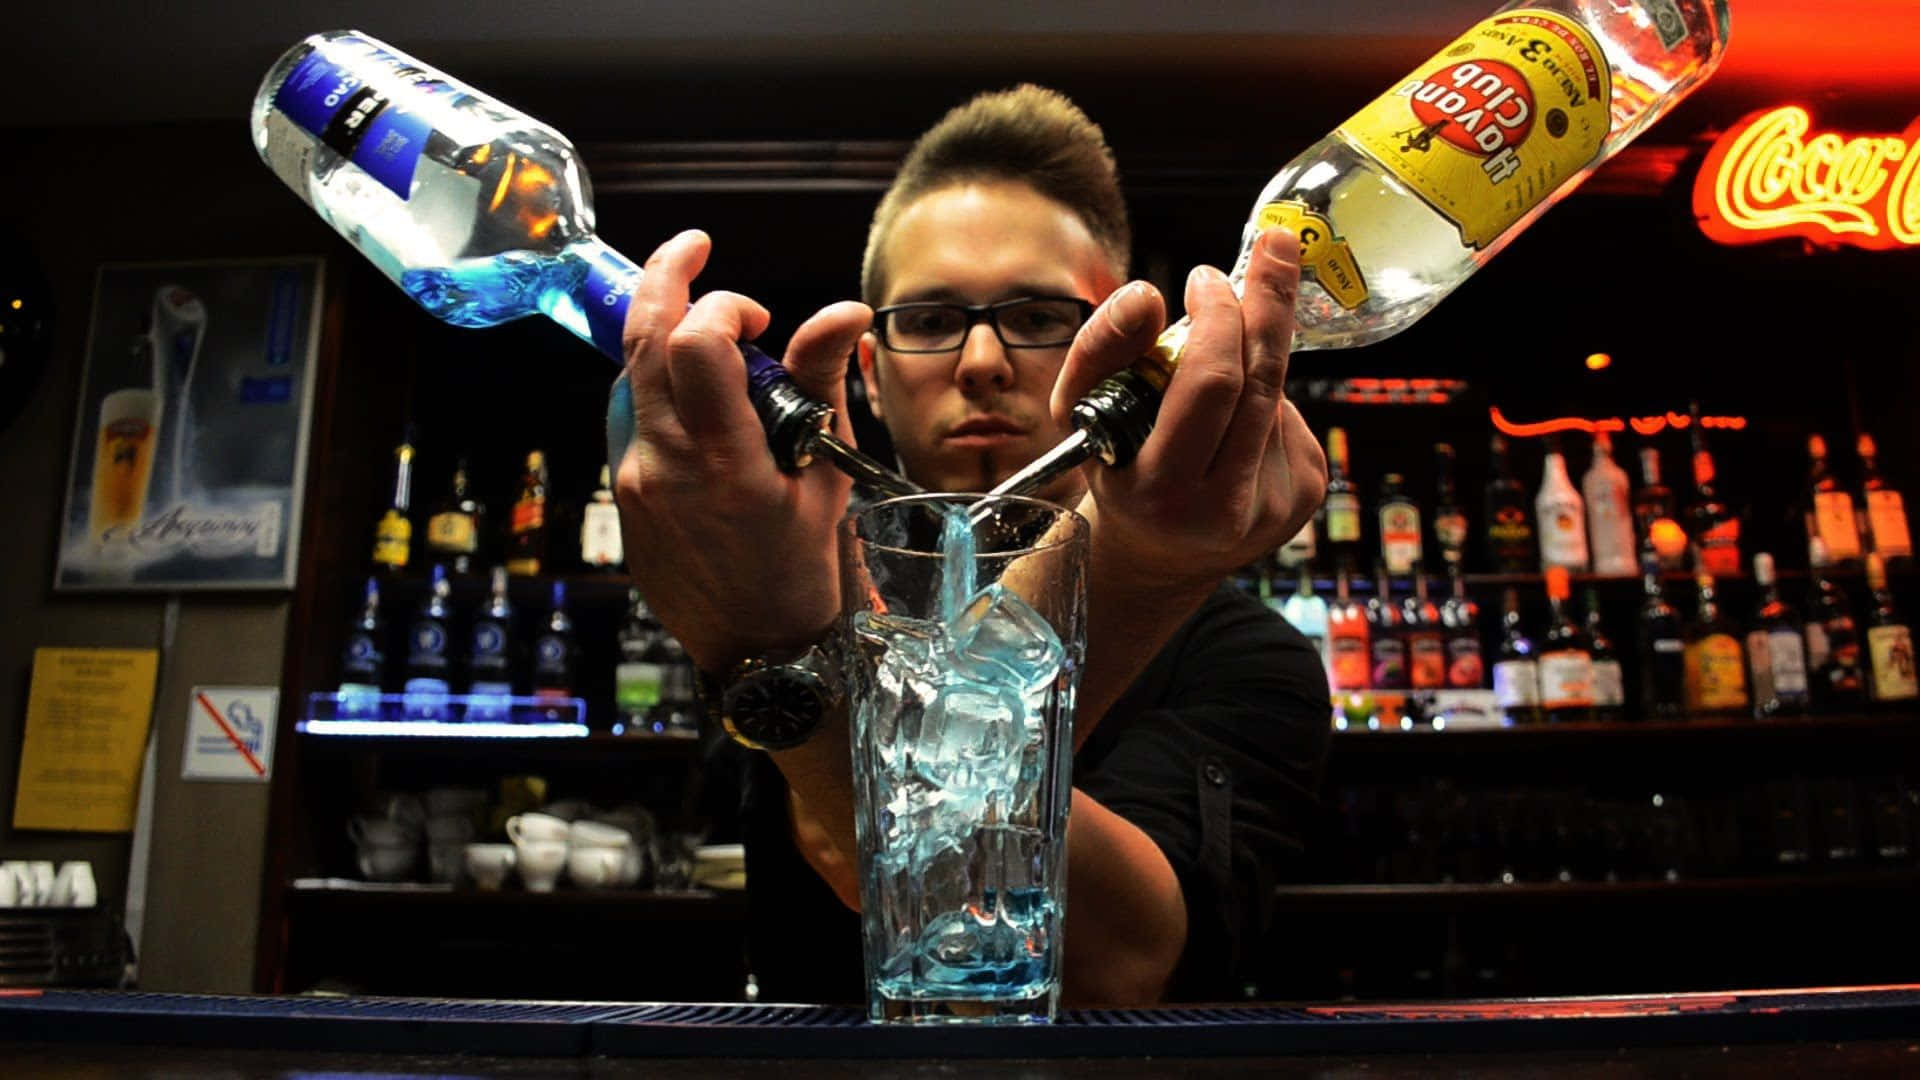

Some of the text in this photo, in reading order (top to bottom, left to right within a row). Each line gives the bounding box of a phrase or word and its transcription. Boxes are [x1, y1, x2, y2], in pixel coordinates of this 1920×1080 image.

[1519, 38, 1553, 63] 3
[1451, 62, 1530, 129] Club
[1397, 78, 1522, 186] Havana
